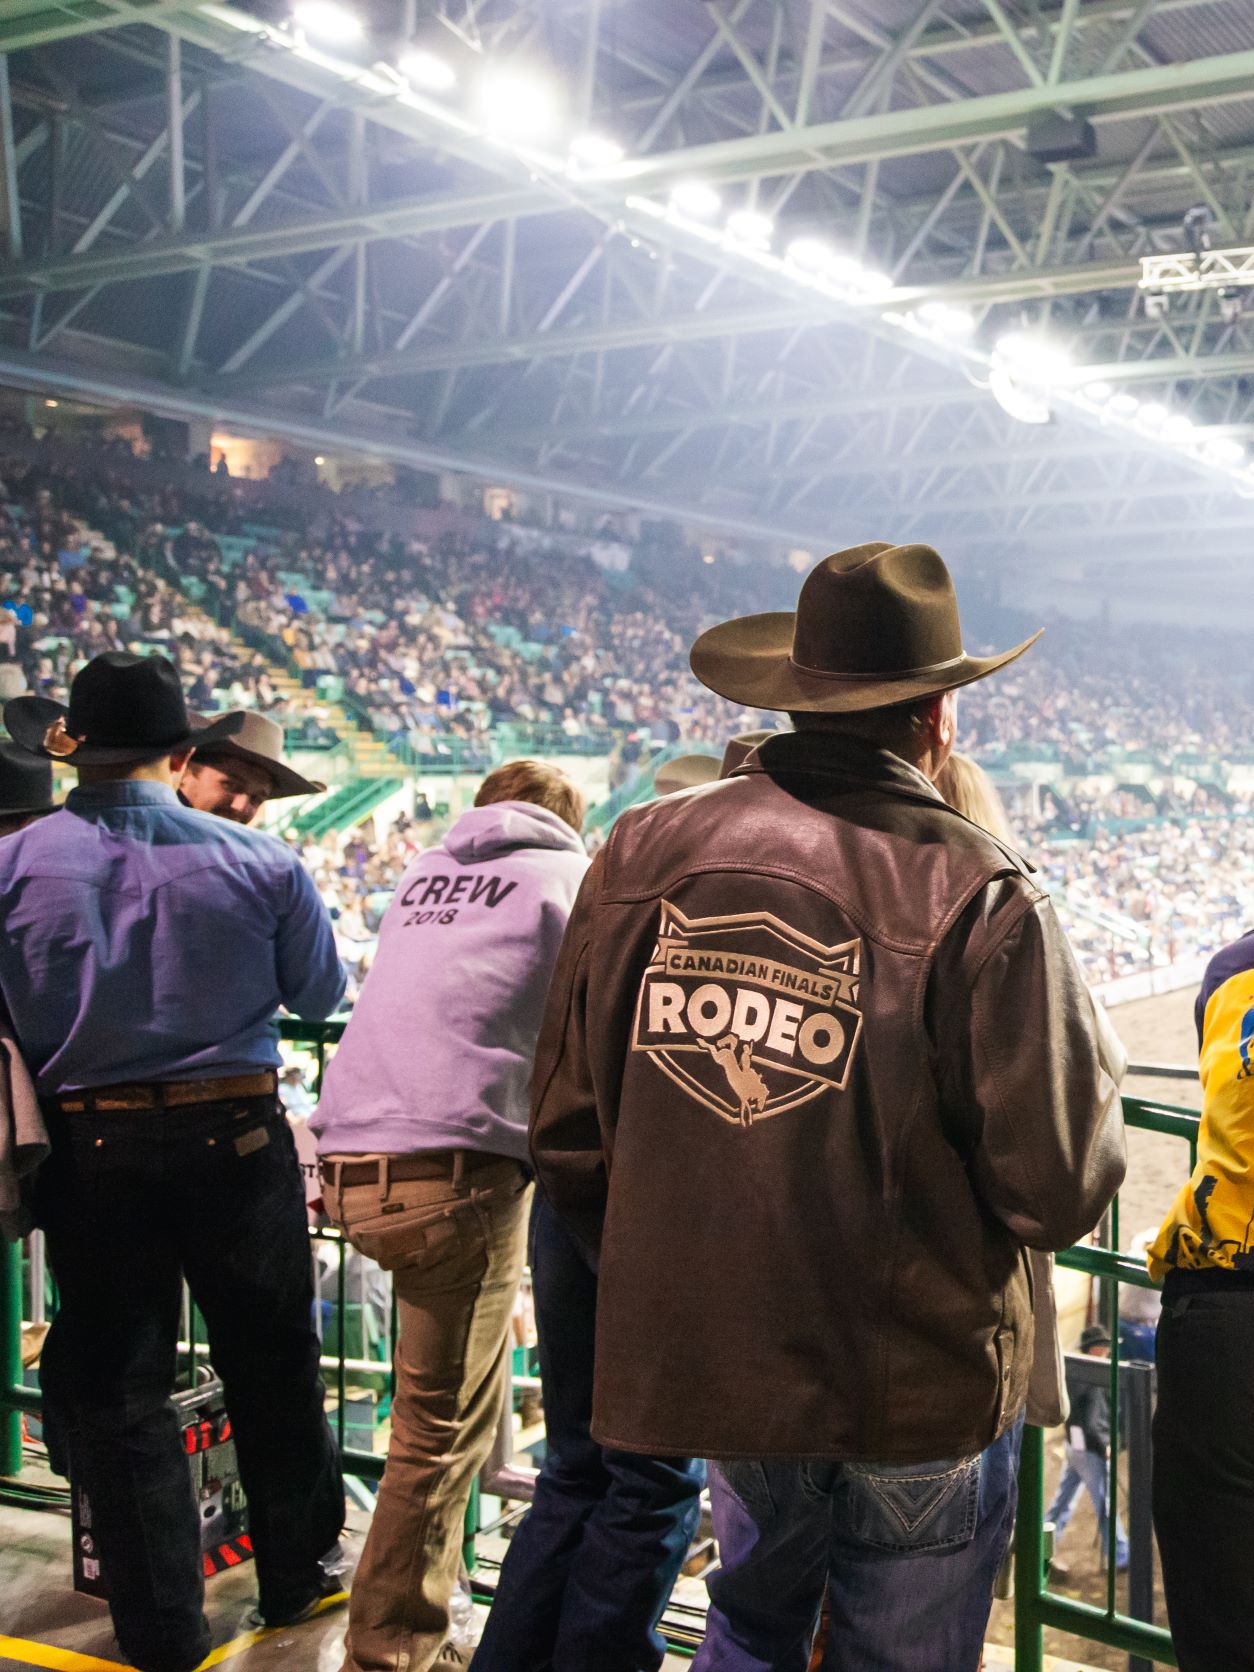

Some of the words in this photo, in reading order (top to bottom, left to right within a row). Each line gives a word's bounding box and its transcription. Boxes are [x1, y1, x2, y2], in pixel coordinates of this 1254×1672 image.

[401, 875, 518, 908] CREW
[403, 908, 459, 927] 2018
[670, 954, 769, 980] CANADIAN
[771, 970, 833, 1000] FINALS
[647, 983, 845, 1064] RODEO
[1237, 1058, 1251, 1079] &
